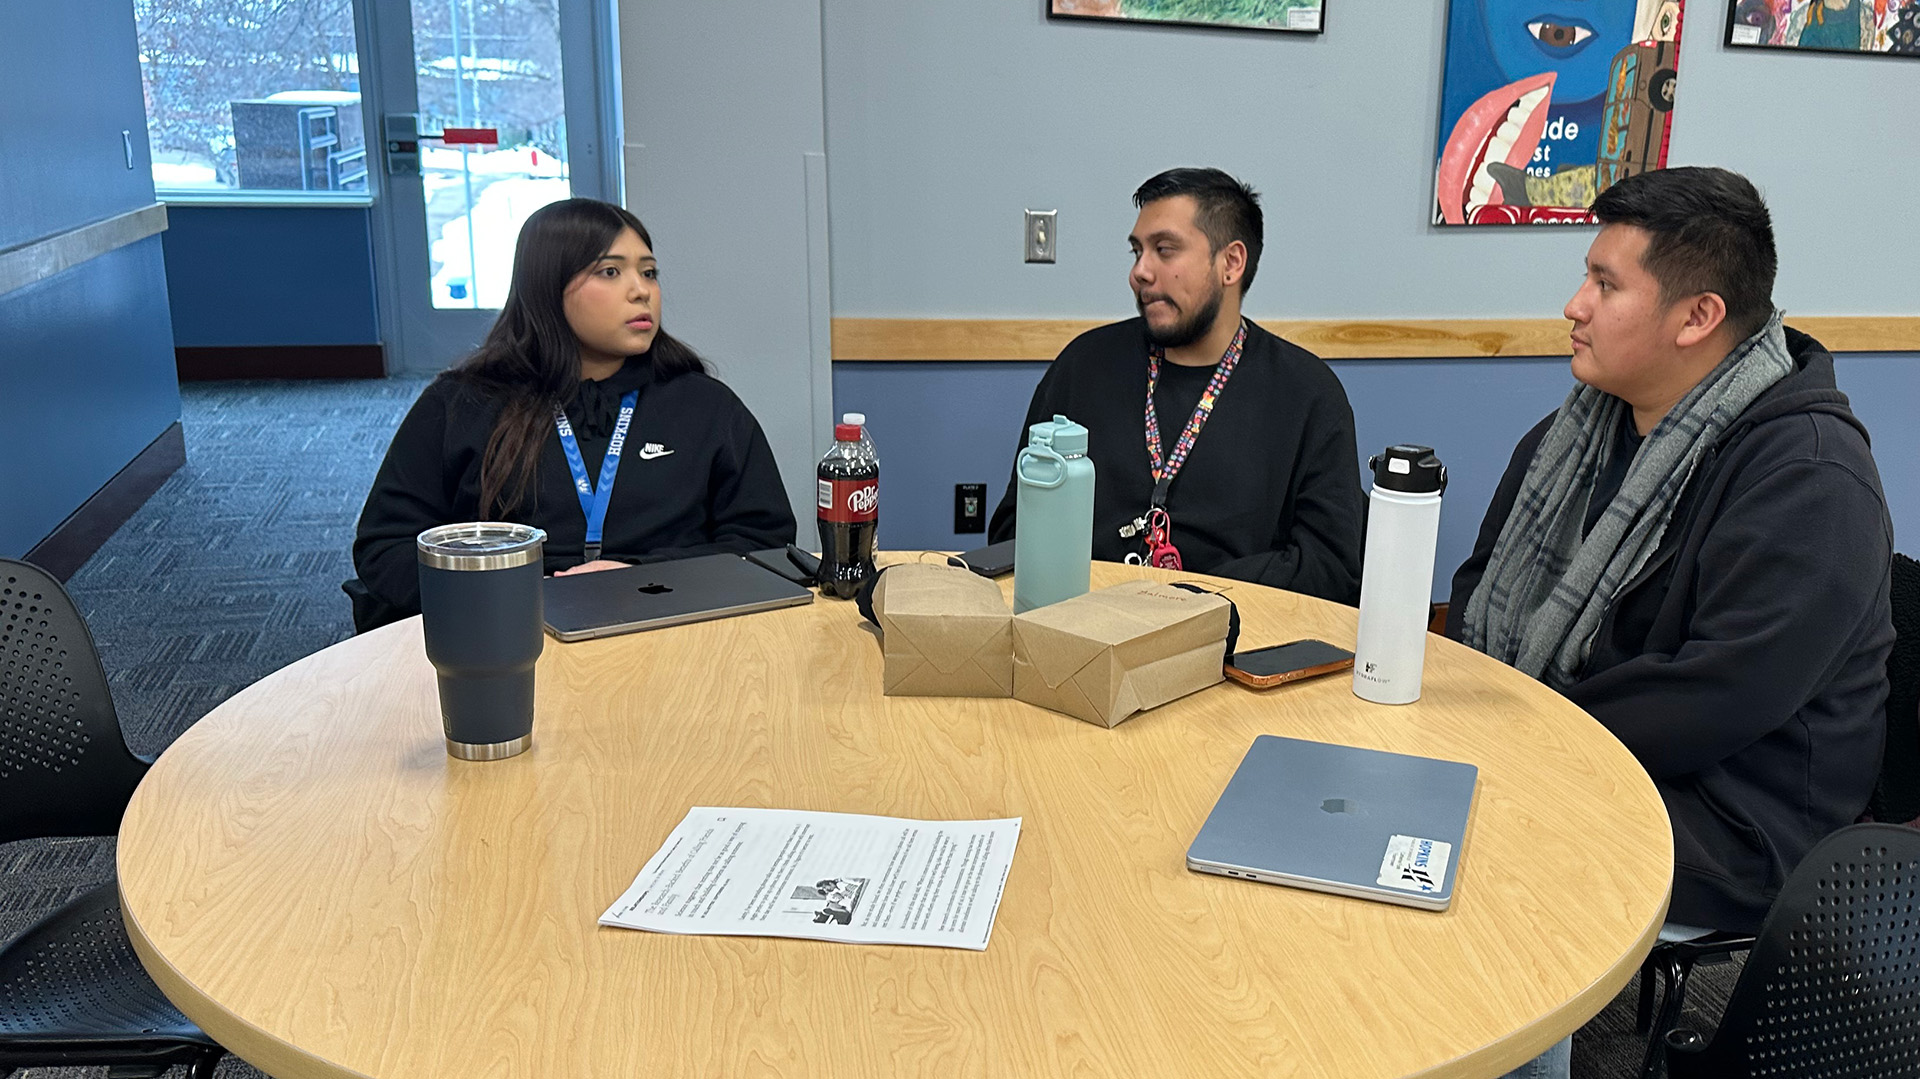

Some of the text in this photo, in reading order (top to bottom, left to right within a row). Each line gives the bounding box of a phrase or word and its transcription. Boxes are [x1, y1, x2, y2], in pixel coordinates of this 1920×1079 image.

[607, 407, 634, 457] HOPKINS
[644, 442, 665, 454] NIKE
[1414, 840, 1433, 867] HOPKINS
